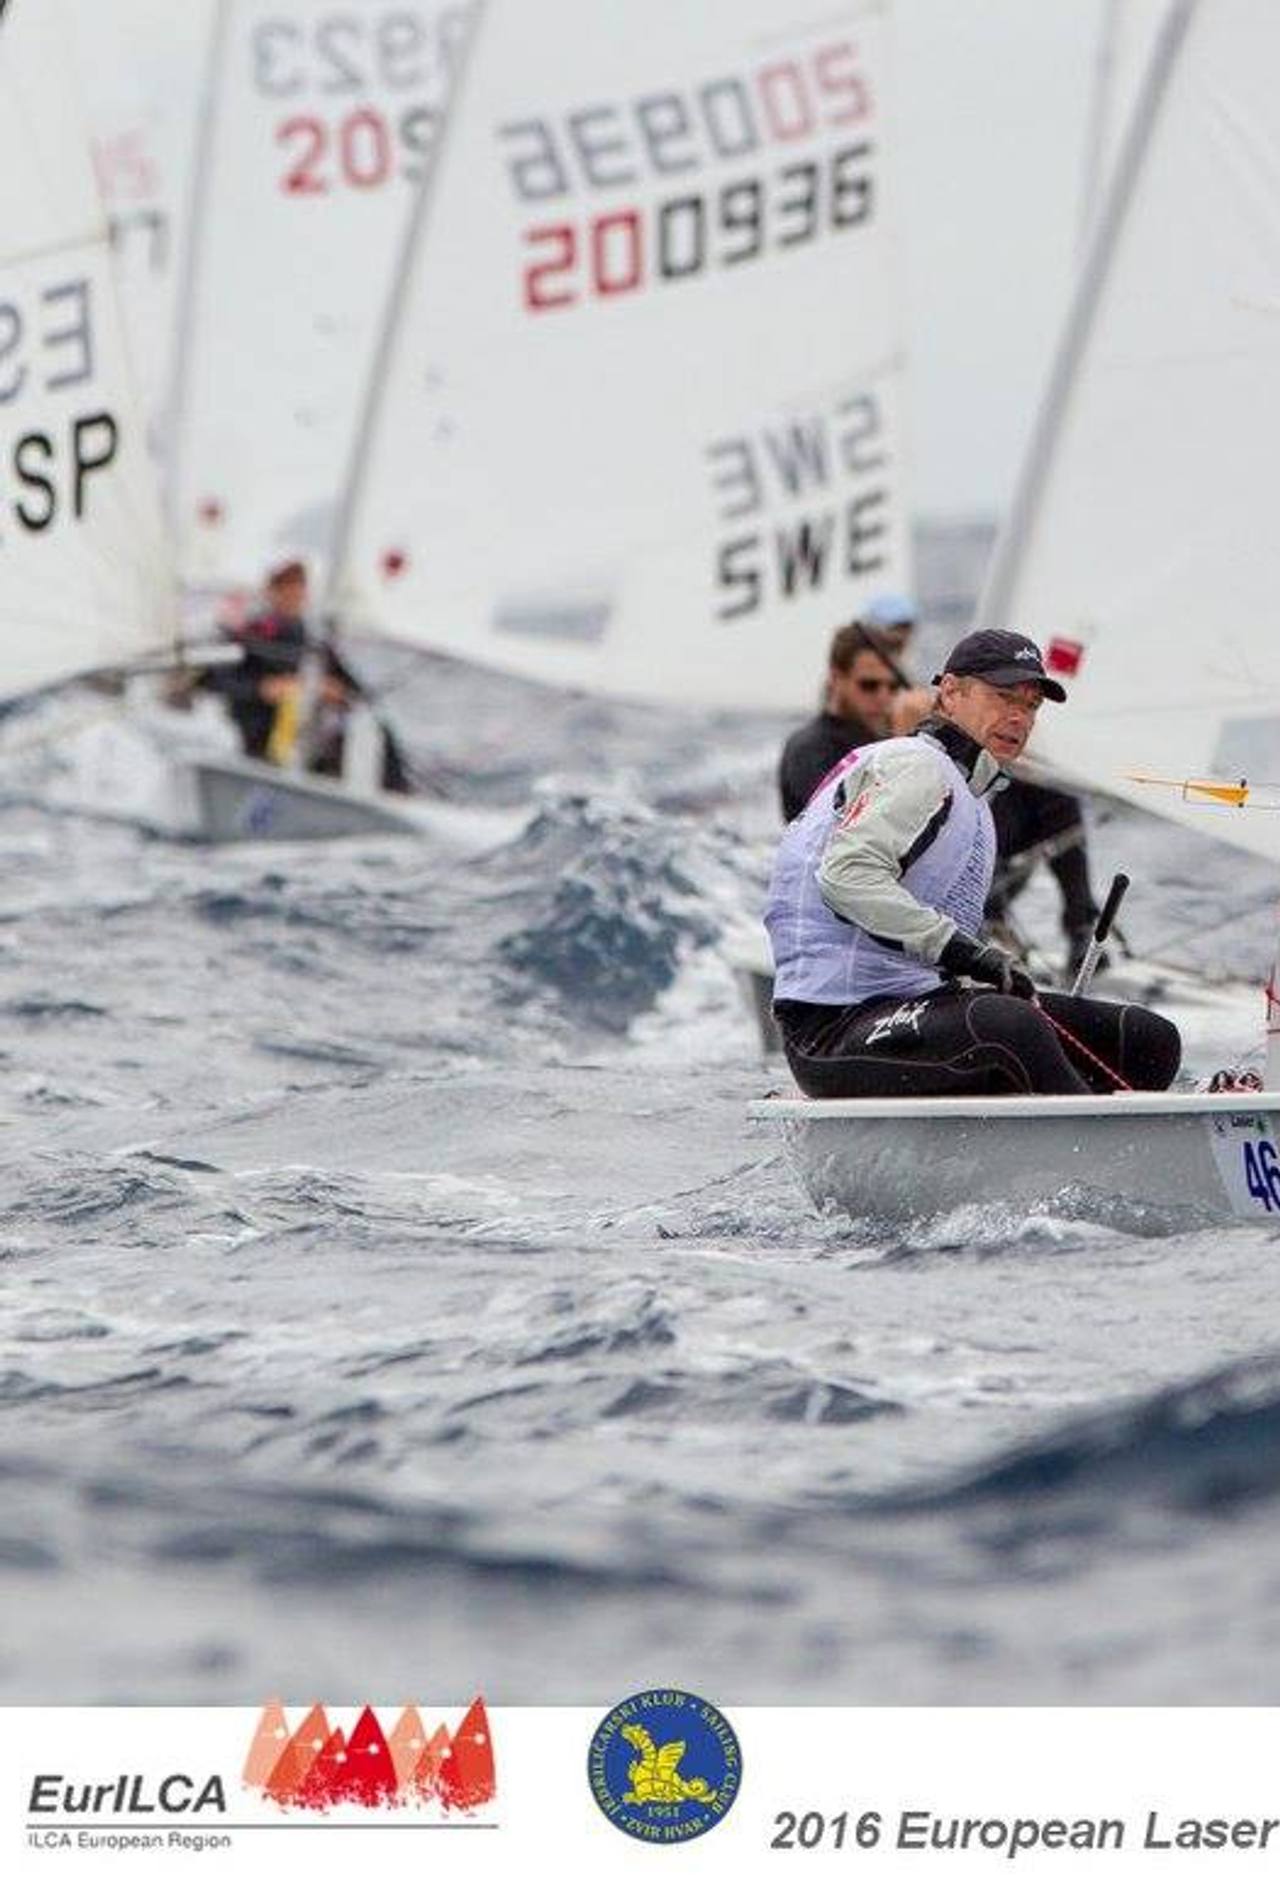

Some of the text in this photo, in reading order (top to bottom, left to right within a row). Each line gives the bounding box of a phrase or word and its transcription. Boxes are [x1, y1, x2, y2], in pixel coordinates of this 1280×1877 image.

[522, 142, 873, 312] 200936
[0, 413, 118, 548] SP
[716, 490, 888, 621] SWE
